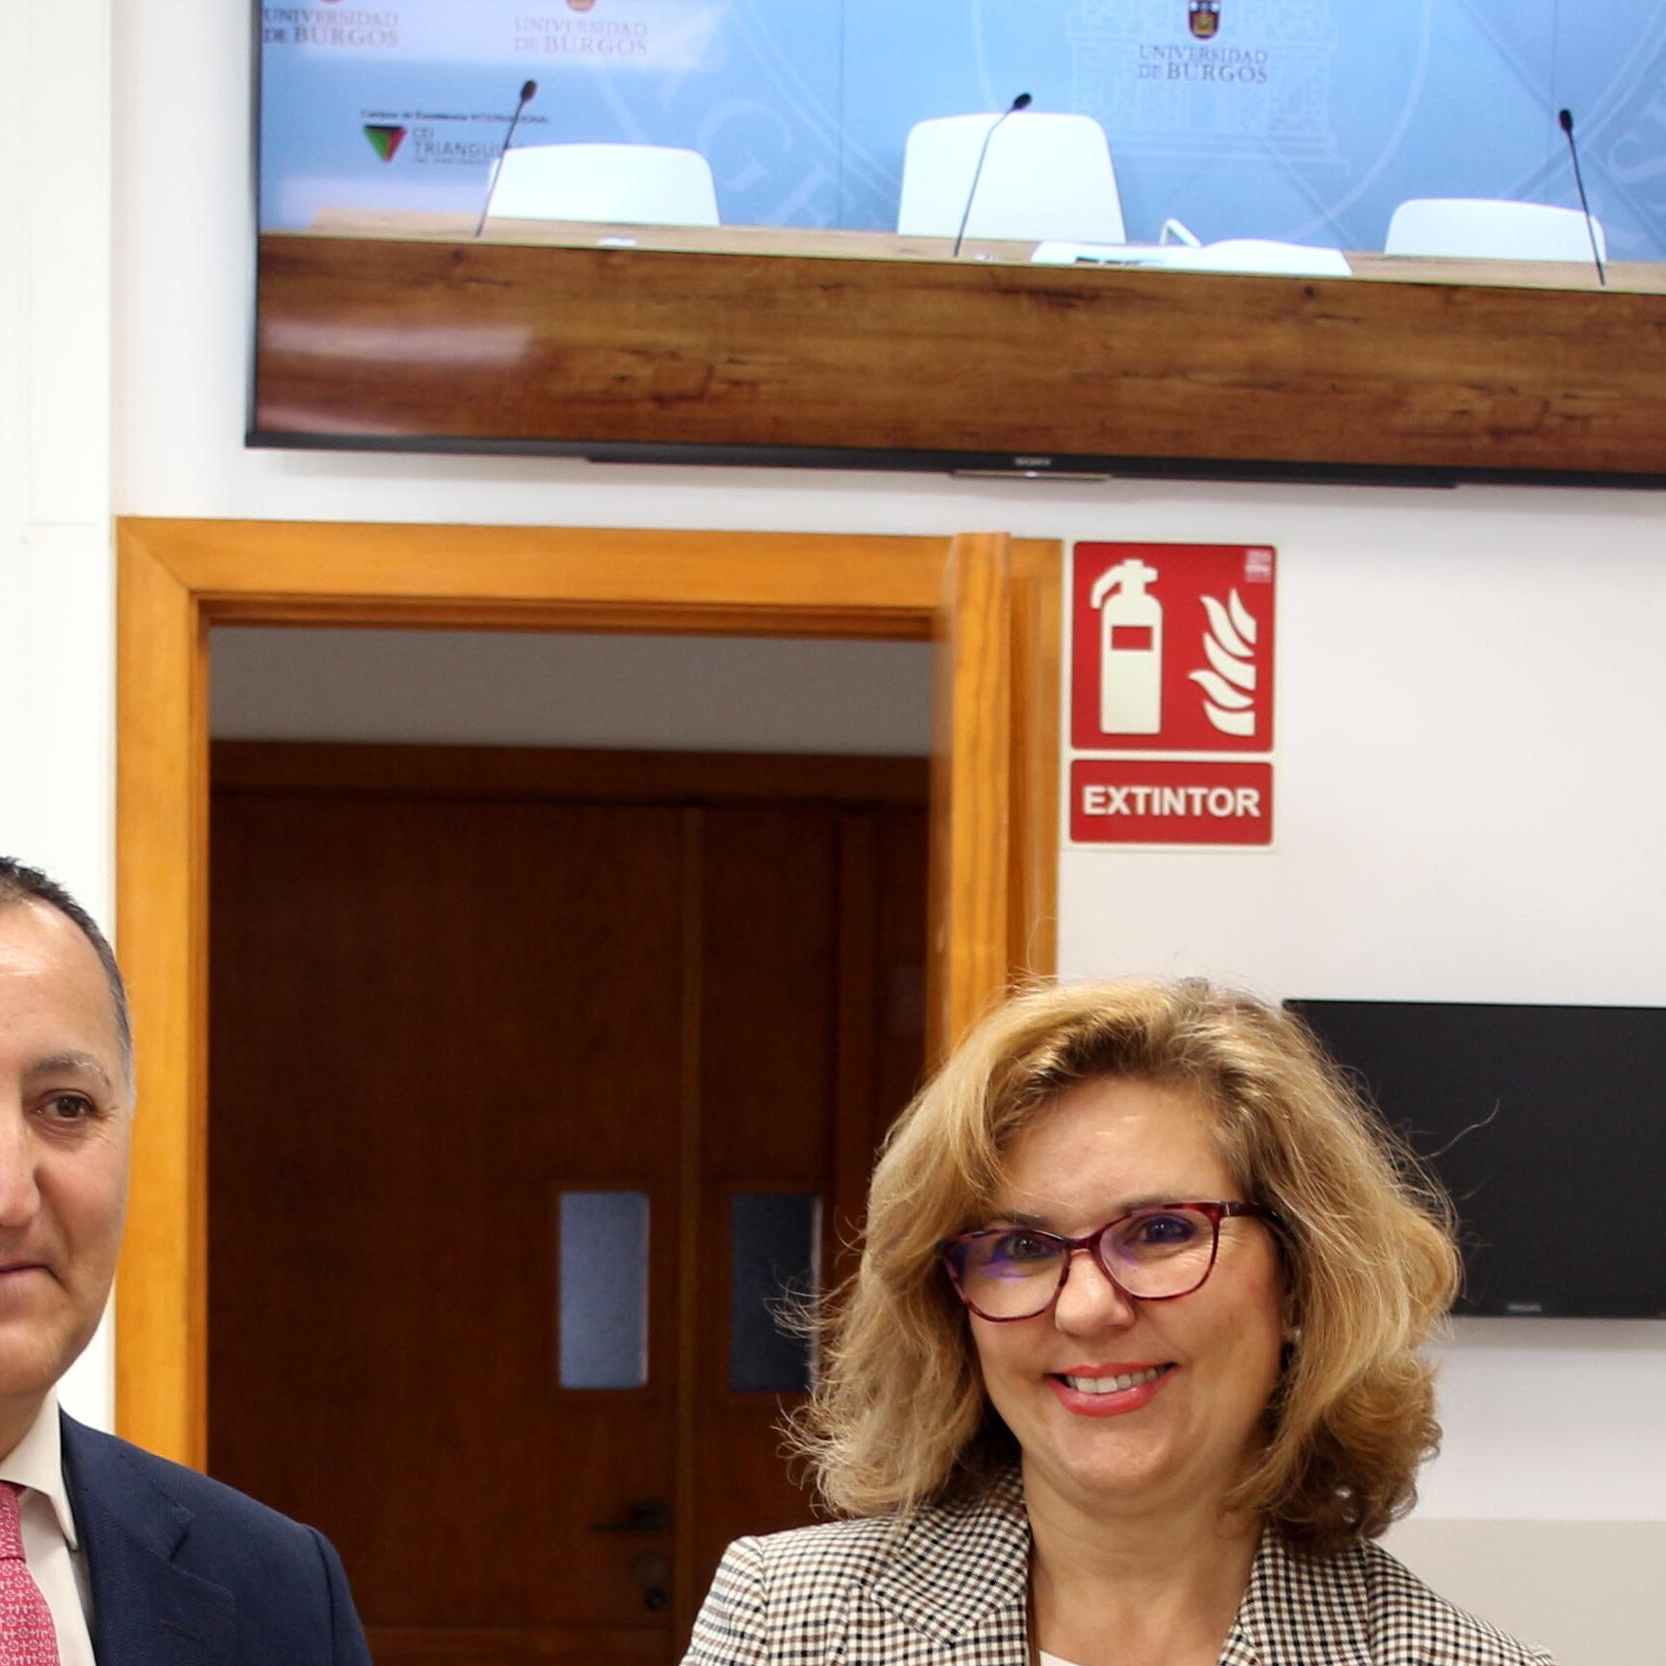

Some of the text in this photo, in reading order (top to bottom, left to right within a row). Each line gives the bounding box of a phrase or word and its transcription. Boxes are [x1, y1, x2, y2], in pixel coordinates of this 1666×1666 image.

[1138, 45, 1270, 66] UNIVERSIDAD
[1138, 61, 1269, 84] DE BURGOS
[1083, 785, 1261, 817] EXTINTOR
